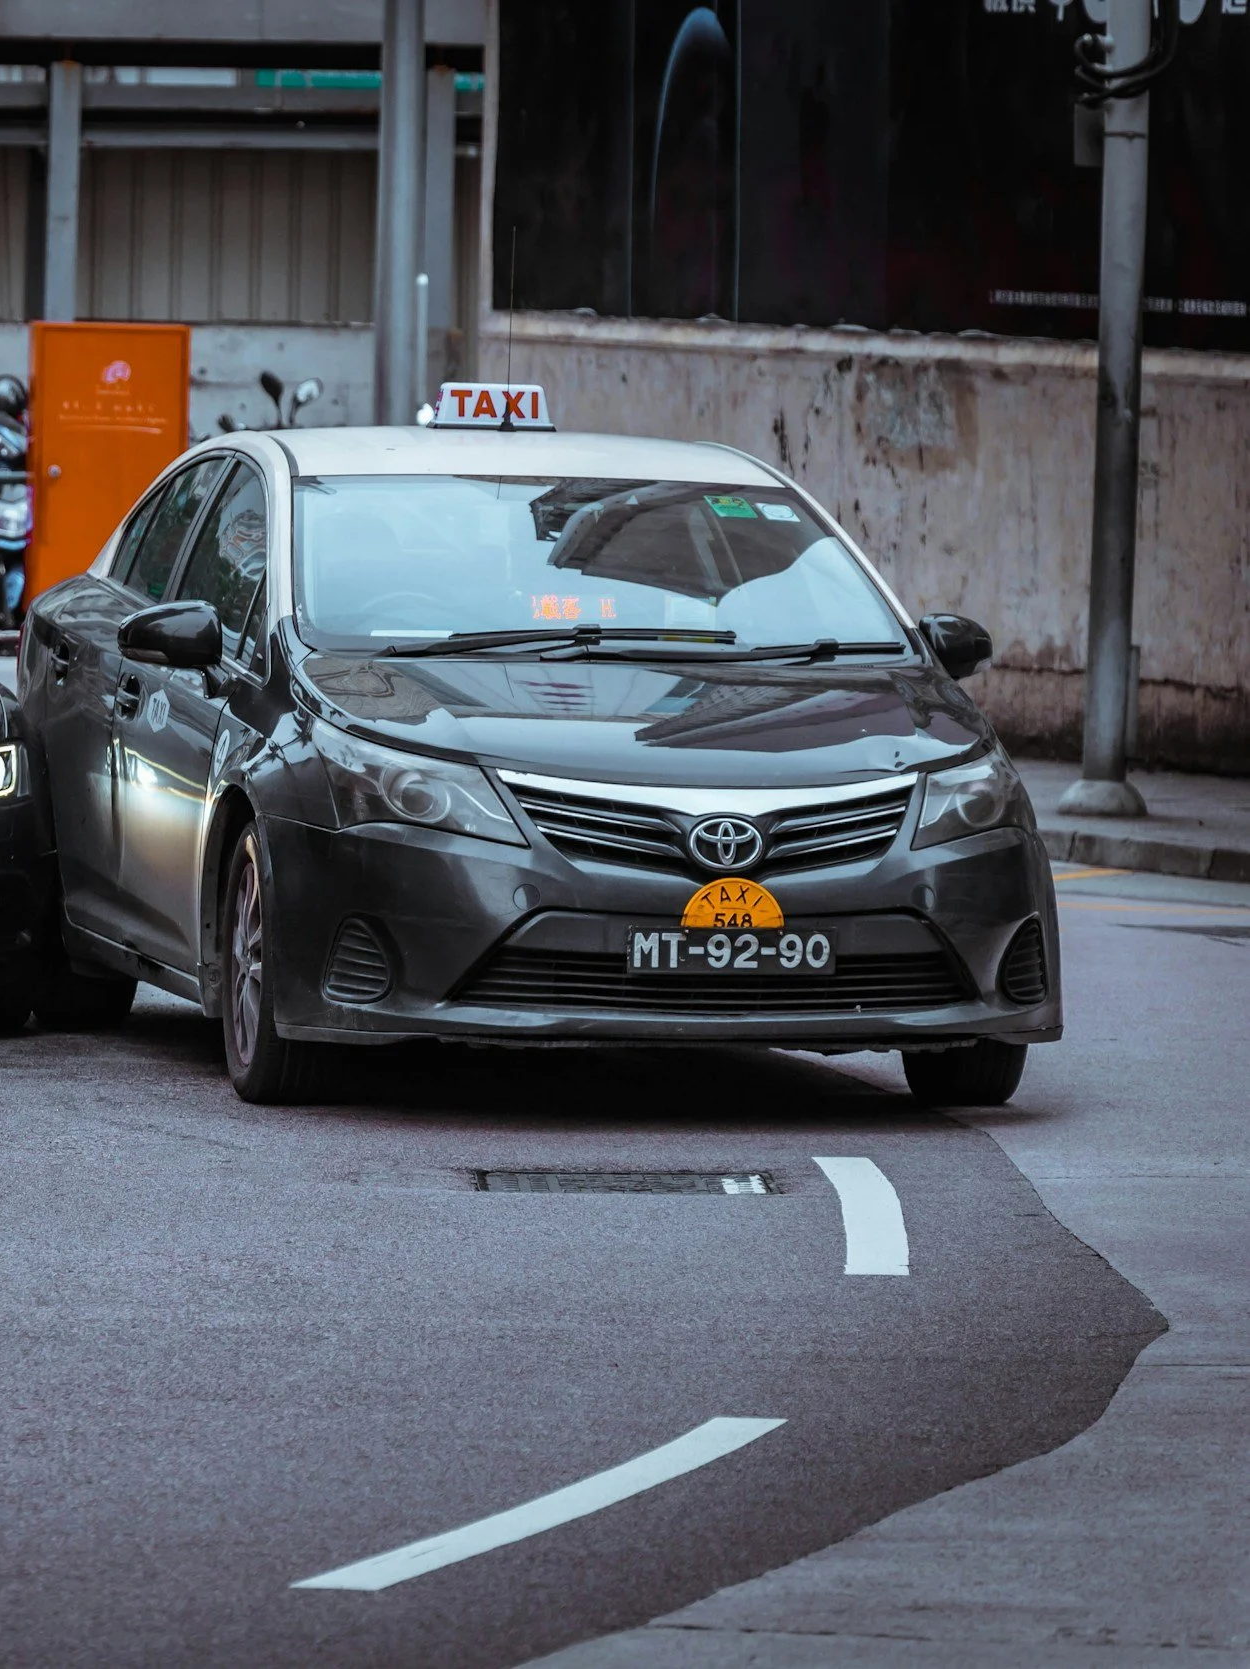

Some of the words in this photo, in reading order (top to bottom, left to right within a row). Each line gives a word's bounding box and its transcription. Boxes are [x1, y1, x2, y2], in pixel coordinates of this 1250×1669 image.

[450, 389, 539, 419] TAXI
[701, 885, 763, 909] TAXI
[713, 912, 753, 928] 548
[632, 932, 831, 969] MT-92-90
